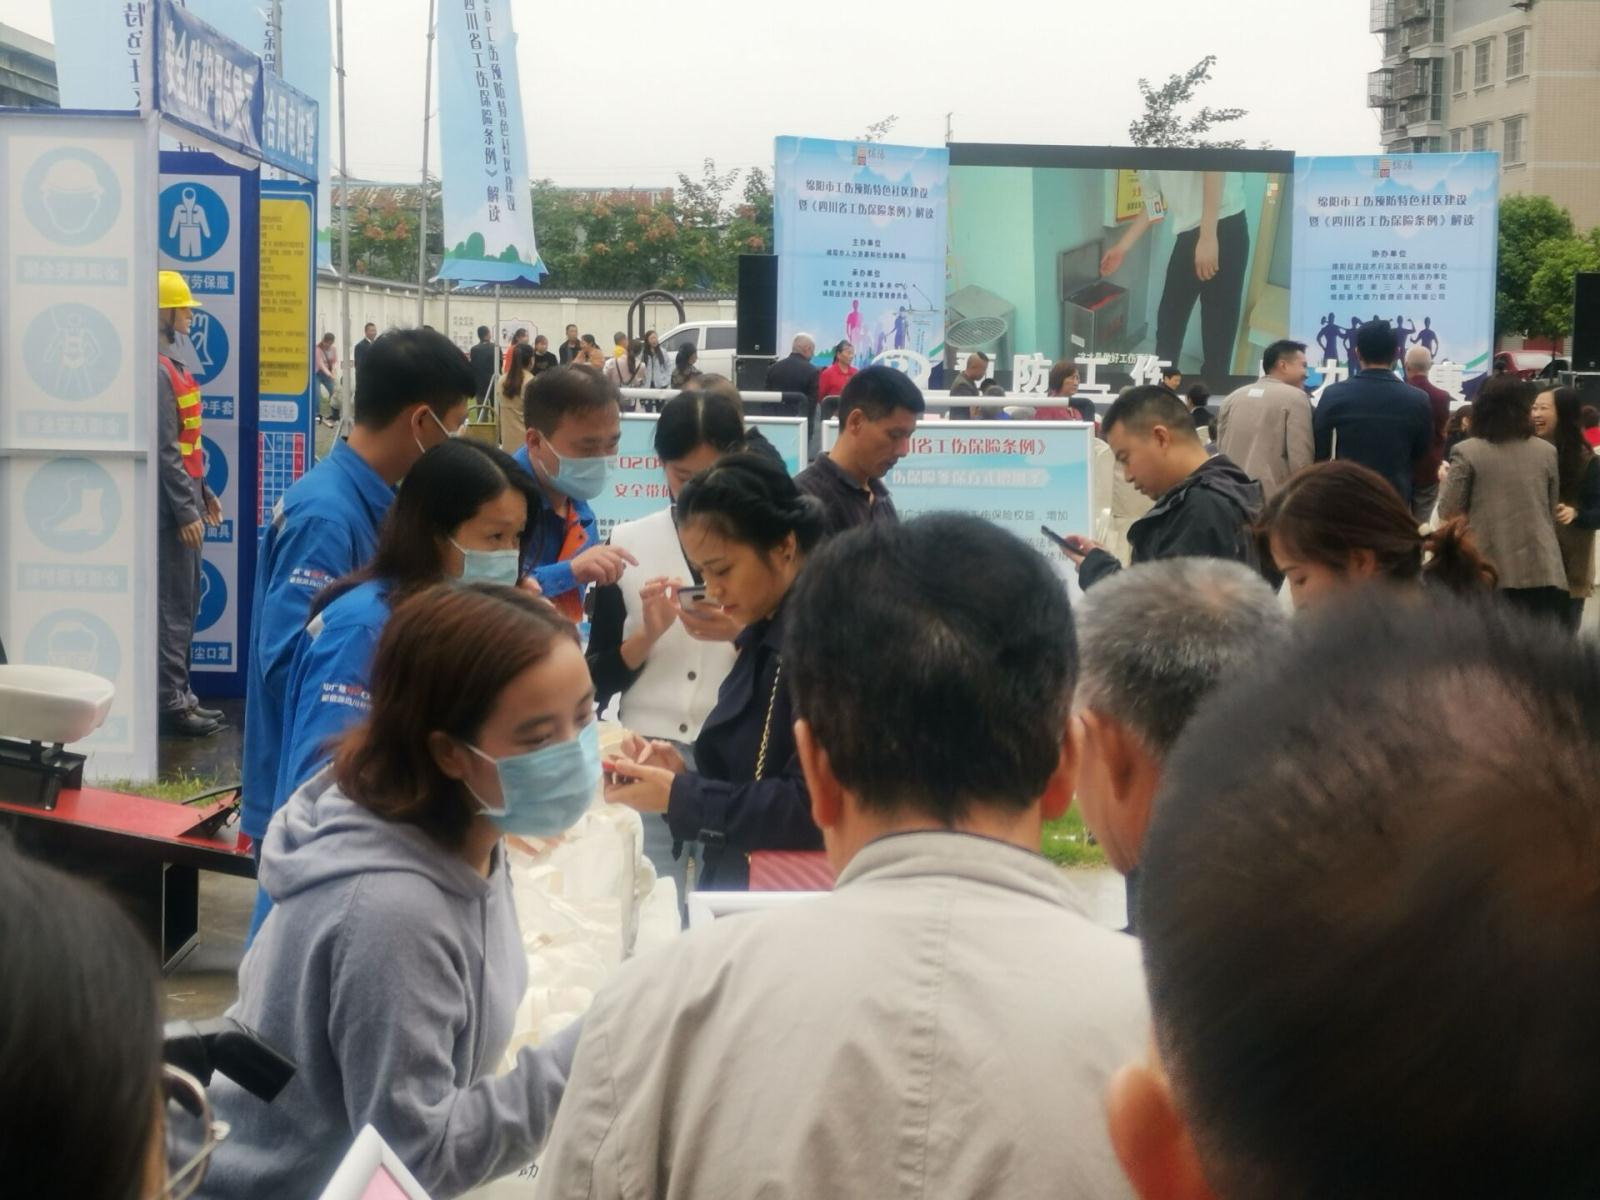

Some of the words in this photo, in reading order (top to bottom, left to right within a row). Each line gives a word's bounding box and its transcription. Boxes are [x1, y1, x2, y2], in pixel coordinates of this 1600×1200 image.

[483, 0, 516, 212] 市工伤预防特色社区建设
[806, 178, 928, 199] 绵阳市工伤预防特色社区建设
[1317, 194, 1468, 208] 绵阳市工伤预防特色社区建设
[1309, 214, 1475, 227] 暨《四川省工伤保险条例》解读
[191, 645, 230, 661] 尘口罩
